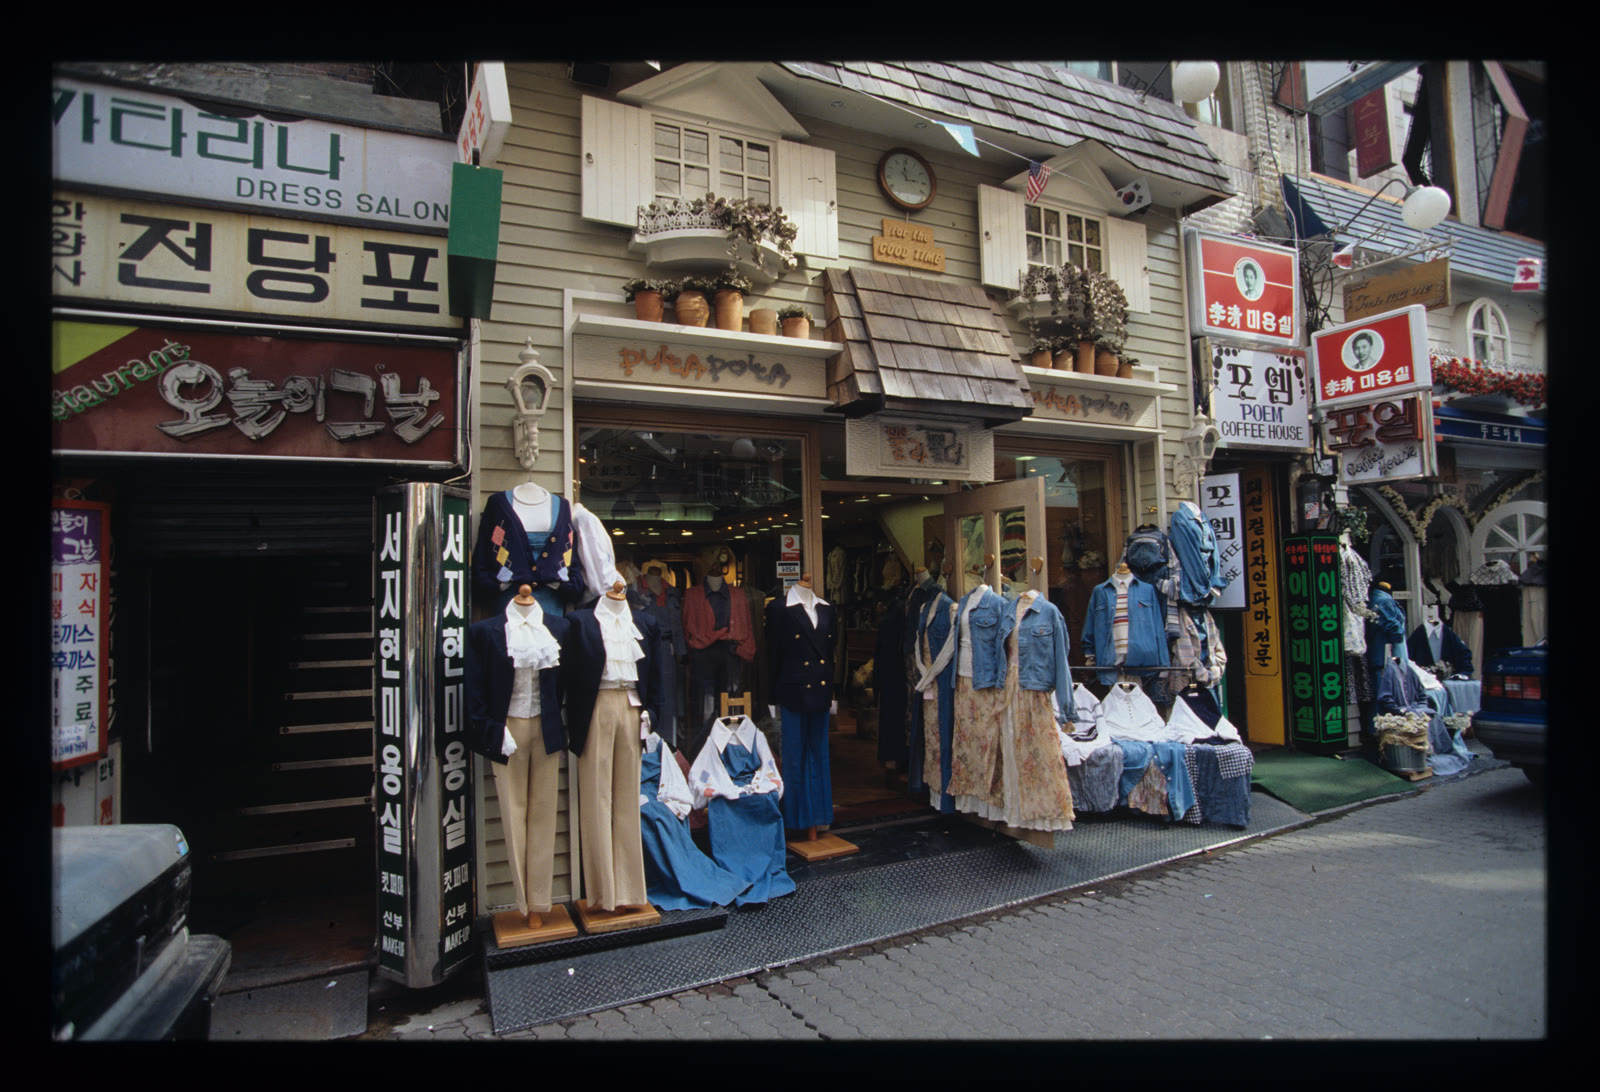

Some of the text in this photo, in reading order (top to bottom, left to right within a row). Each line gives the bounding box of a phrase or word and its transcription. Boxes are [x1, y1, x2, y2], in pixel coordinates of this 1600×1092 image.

[236, 176, 449, 223] DRESS SALON
[117, 212, 440, 315] 전당포
[879, 242, 943, 265] GOOD TIME
[1247, 308, 1292, 335] 미용실
[1226, 363, 1294, 406] 포엠
[1359, 365, 1410, 389] 미용실
[1240, 403, 1284, 423] POEM
[1221, 420, 1304, 441] COFFEE HOUSE
[1252, 628, 1272, 668] 전문
[383, 910, 403, 931] 신부
[445, 902, 467, 927] 신부
[444, 925, 471, 954] MAKE-UP
